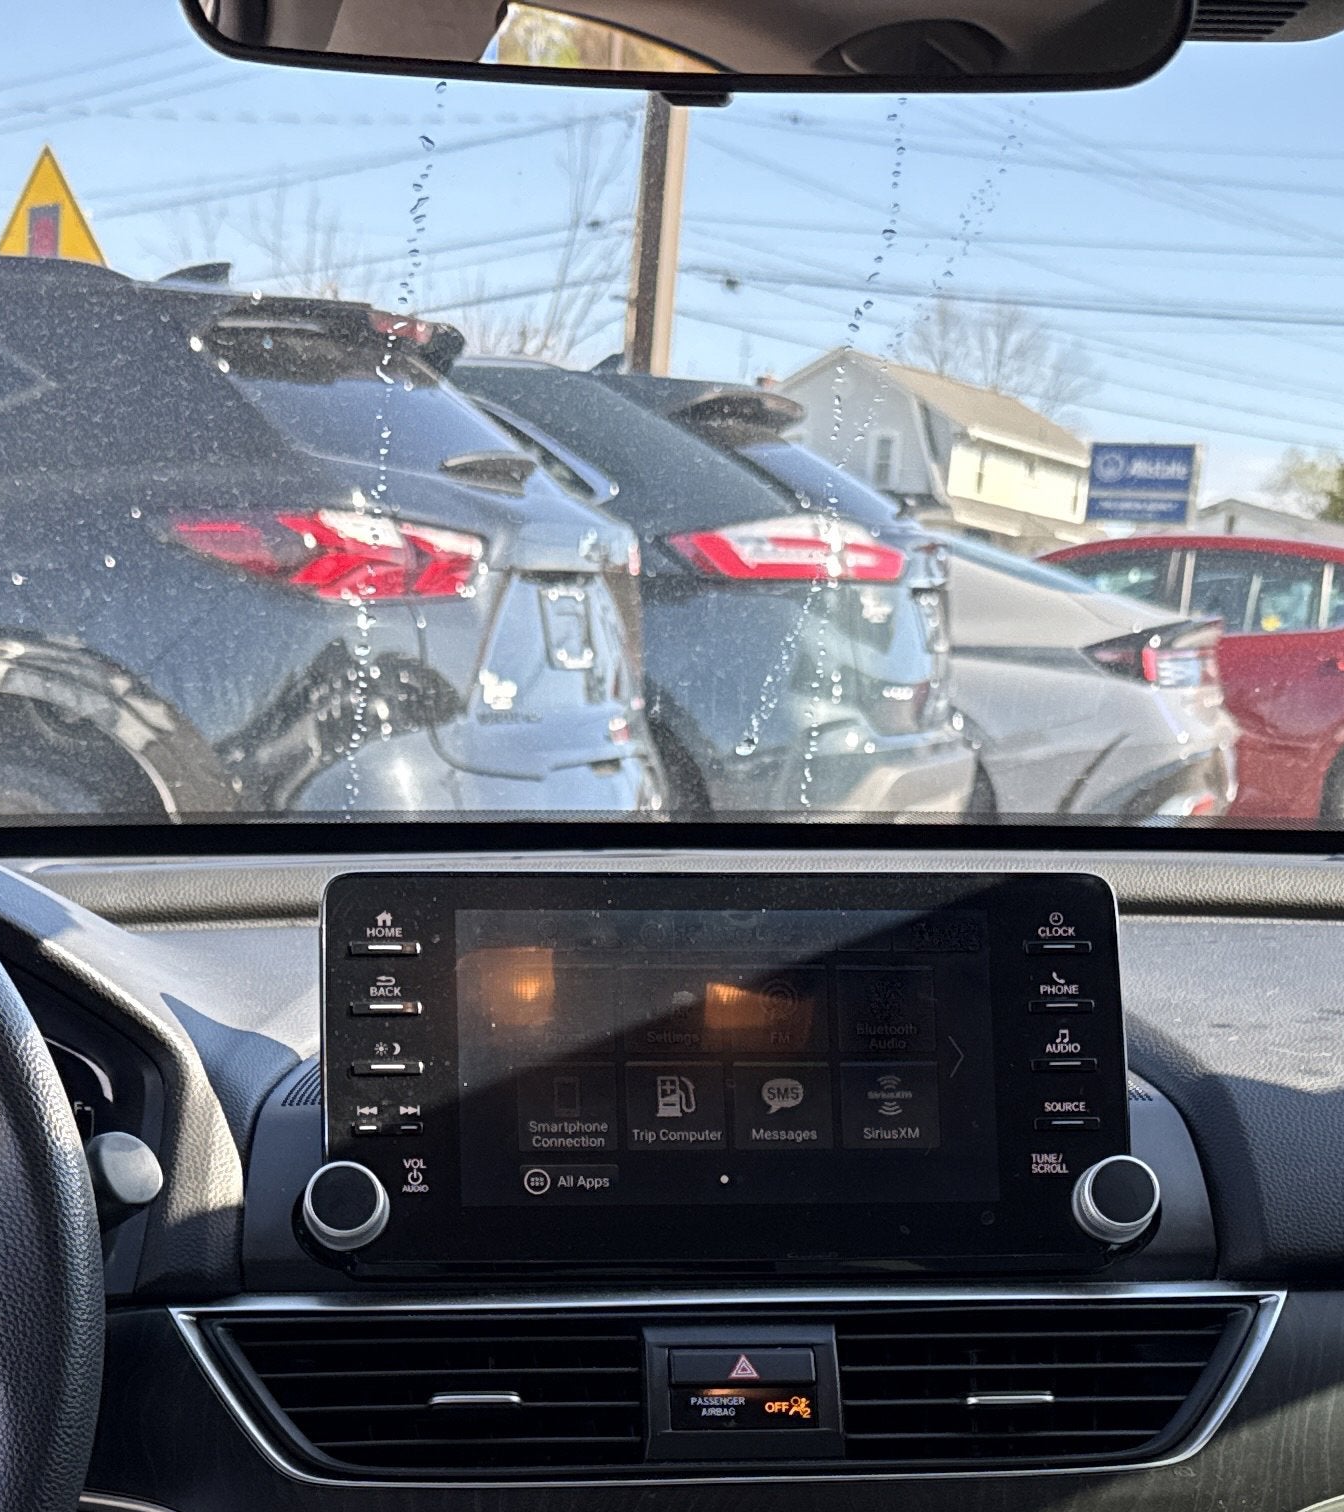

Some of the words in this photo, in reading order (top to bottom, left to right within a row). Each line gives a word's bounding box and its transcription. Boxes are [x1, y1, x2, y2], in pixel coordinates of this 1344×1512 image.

[366, 927, 403, 938] HOME
[1037, 926, 1076, 937] CLOCK
[369, 986, 402, 997] BACK
[1039, 984, 1080, 995] PHONE
[856, 1023, 917, 1035] Bluetooth
[646, 1032, 700, 1046] Settings
[770, 1032, 791, 1044] FM
[869, 1038, 906, 1049] Audio
[1045, 1043, 1081, 1053] AUDIO
[767, 1086, 800, 1101] SMS
[73, 1101, 83, 1115] F
[1044, 1101, 1086, 1112] SOURCE
[528, 1120, 608, 1135] Smartphone
[632, 1129, 656, 1143] Trip
[659, 1128, 723, 1143] Computer
[751, 1128, 818, 1143] Messages
[863, 1127, 920, 1140] SiriusXM
[532, 1135, 605, 1148] Connection
[402, 1158, 427, 1169] VOL
[1031, 1153, 1063, 1163] TUNE/
[1031, 1163, 1069, 1174] SCROLL
[401, 1184, 430, 1193] AUDIO
[557, 1175, 574, 1188] All
[576, 1175, 610, 1191] Apps
[690, 1397, 746, 1406] PASSENGER
[764, 1401, 789, 1413] OFF
[701, 1407, 736, 1417] AIRBAG
